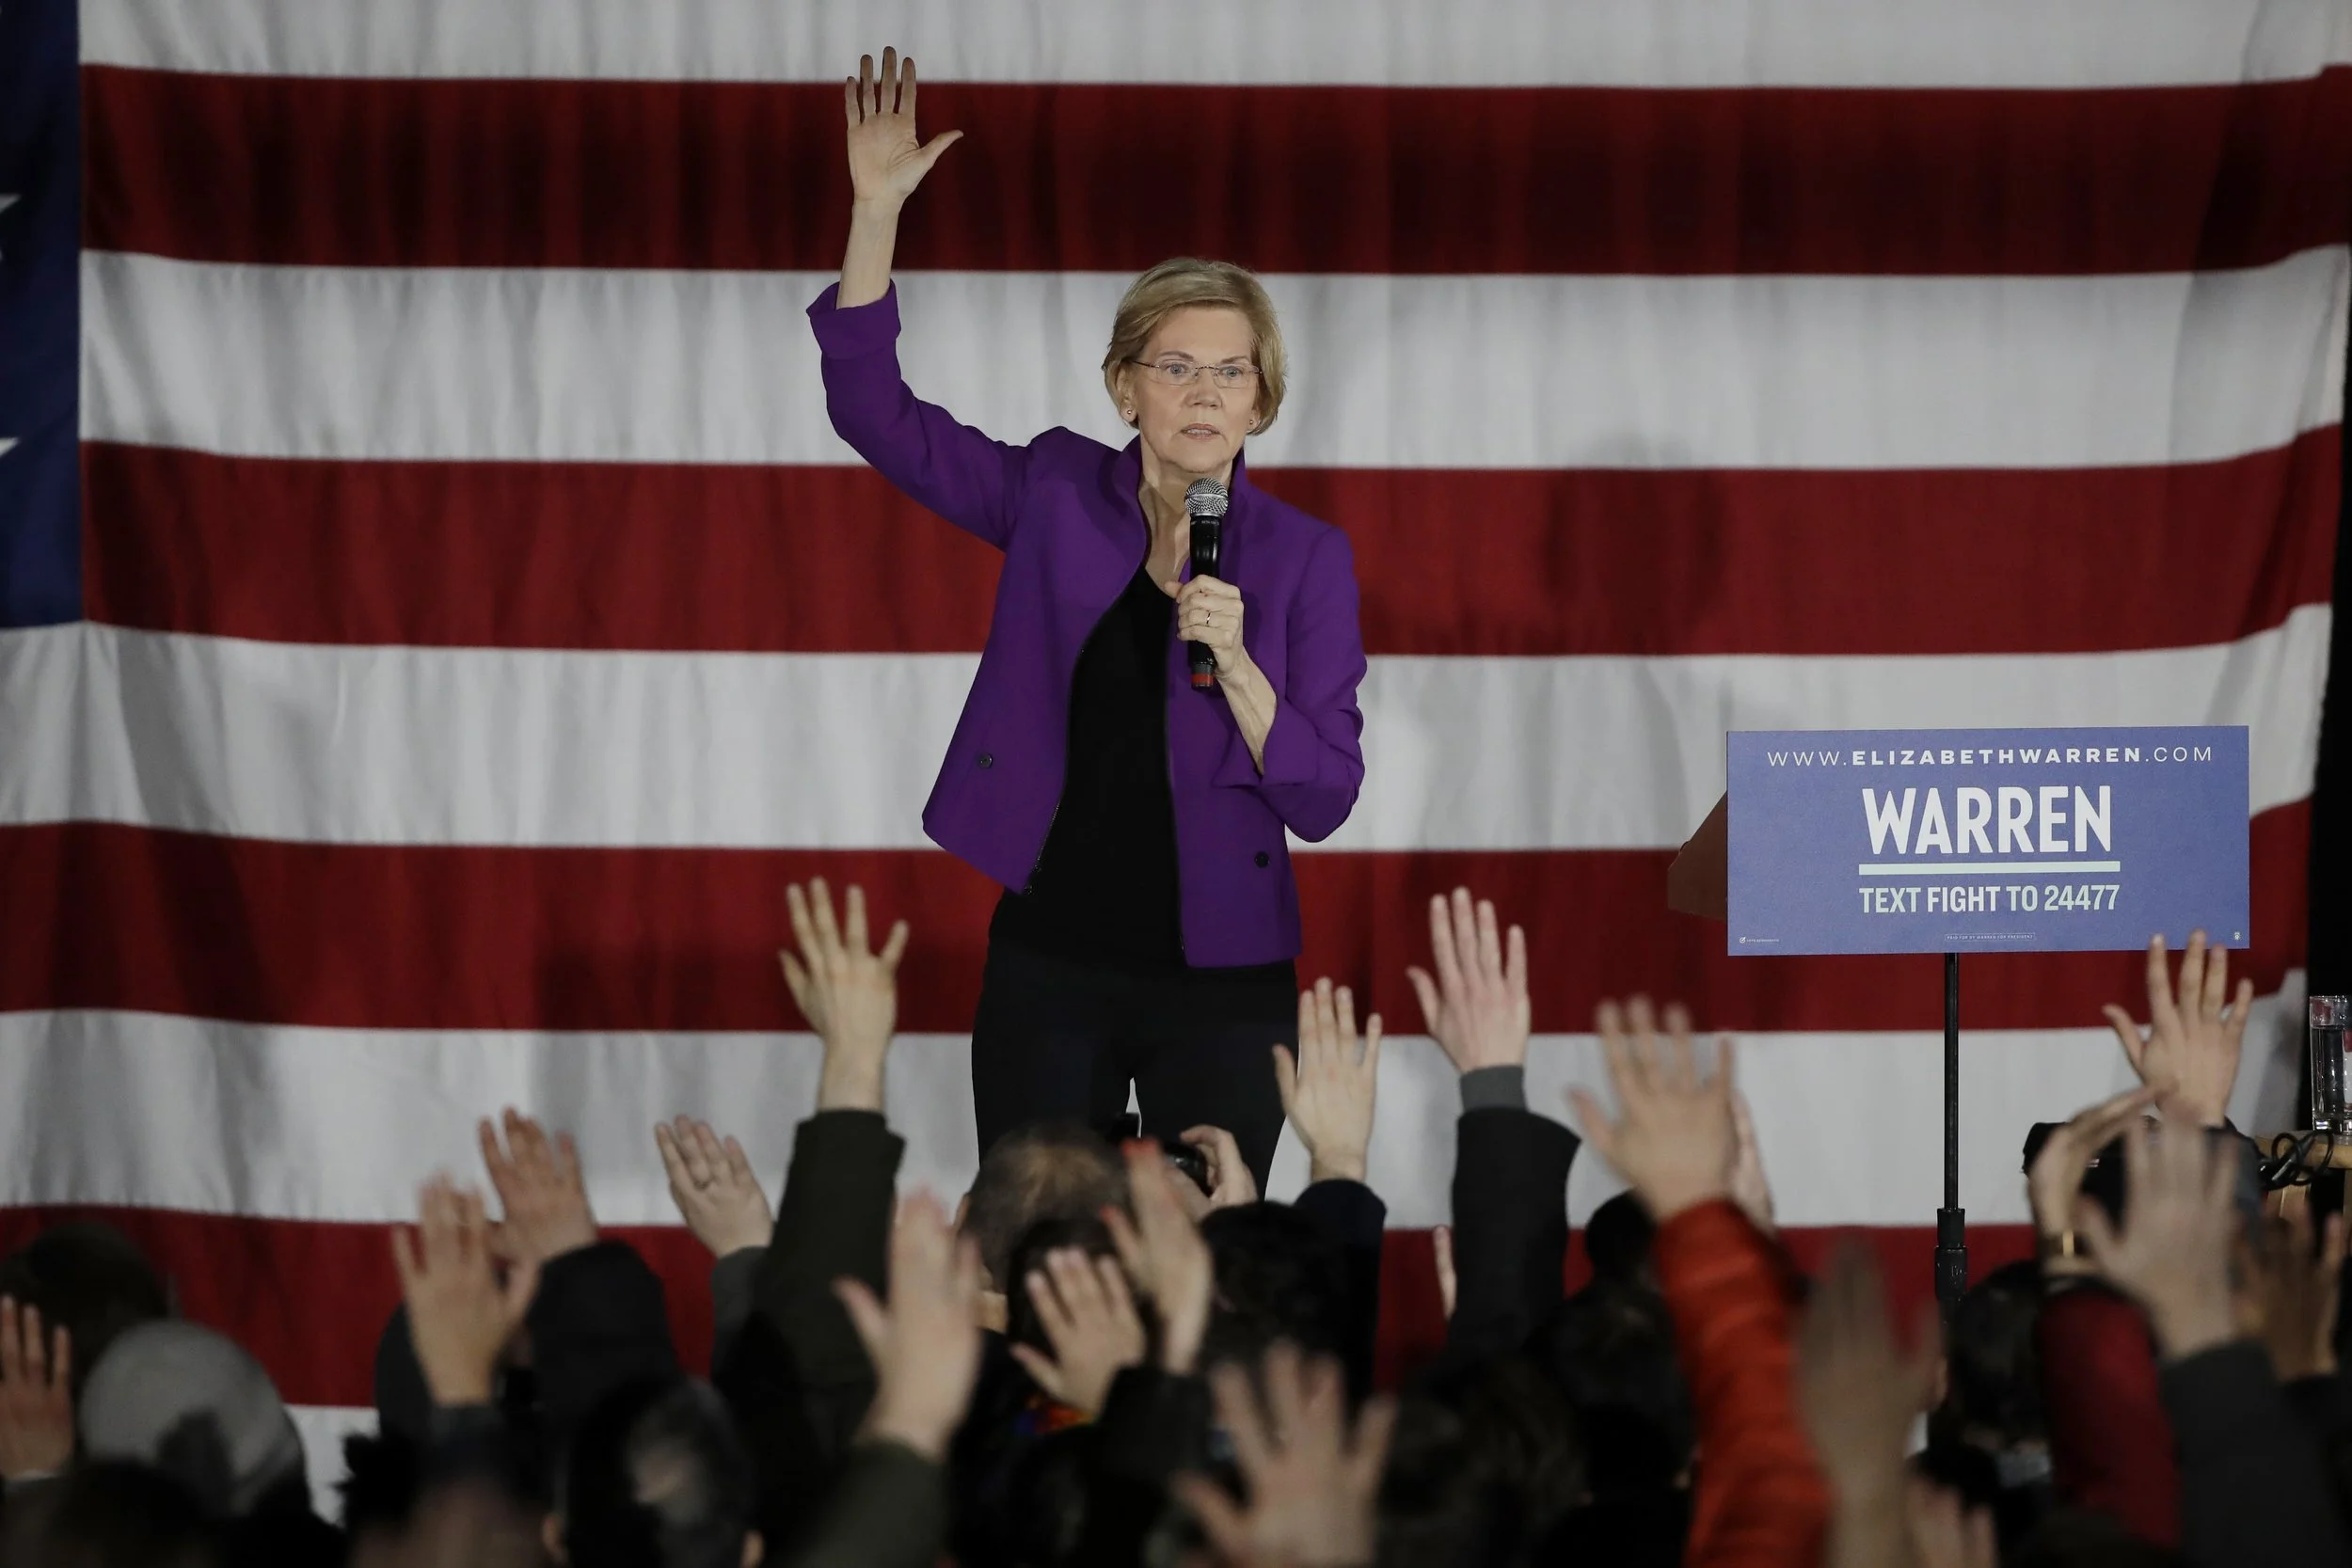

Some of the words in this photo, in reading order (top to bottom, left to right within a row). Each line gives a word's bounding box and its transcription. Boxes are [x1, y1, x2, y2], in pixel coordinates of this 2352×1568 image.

[1767, 746, 2212, 767] WWW.ELIZABETHWARREN.COM
[1861, 784, 2112, 855] WARREN
[1859, 887, 1921, 913] TEXT
[1927, 886, 2001, 913] FIGHT
[2006, 885, 2038, 911] TO
[2043, 884, 2121, 911] 24477
